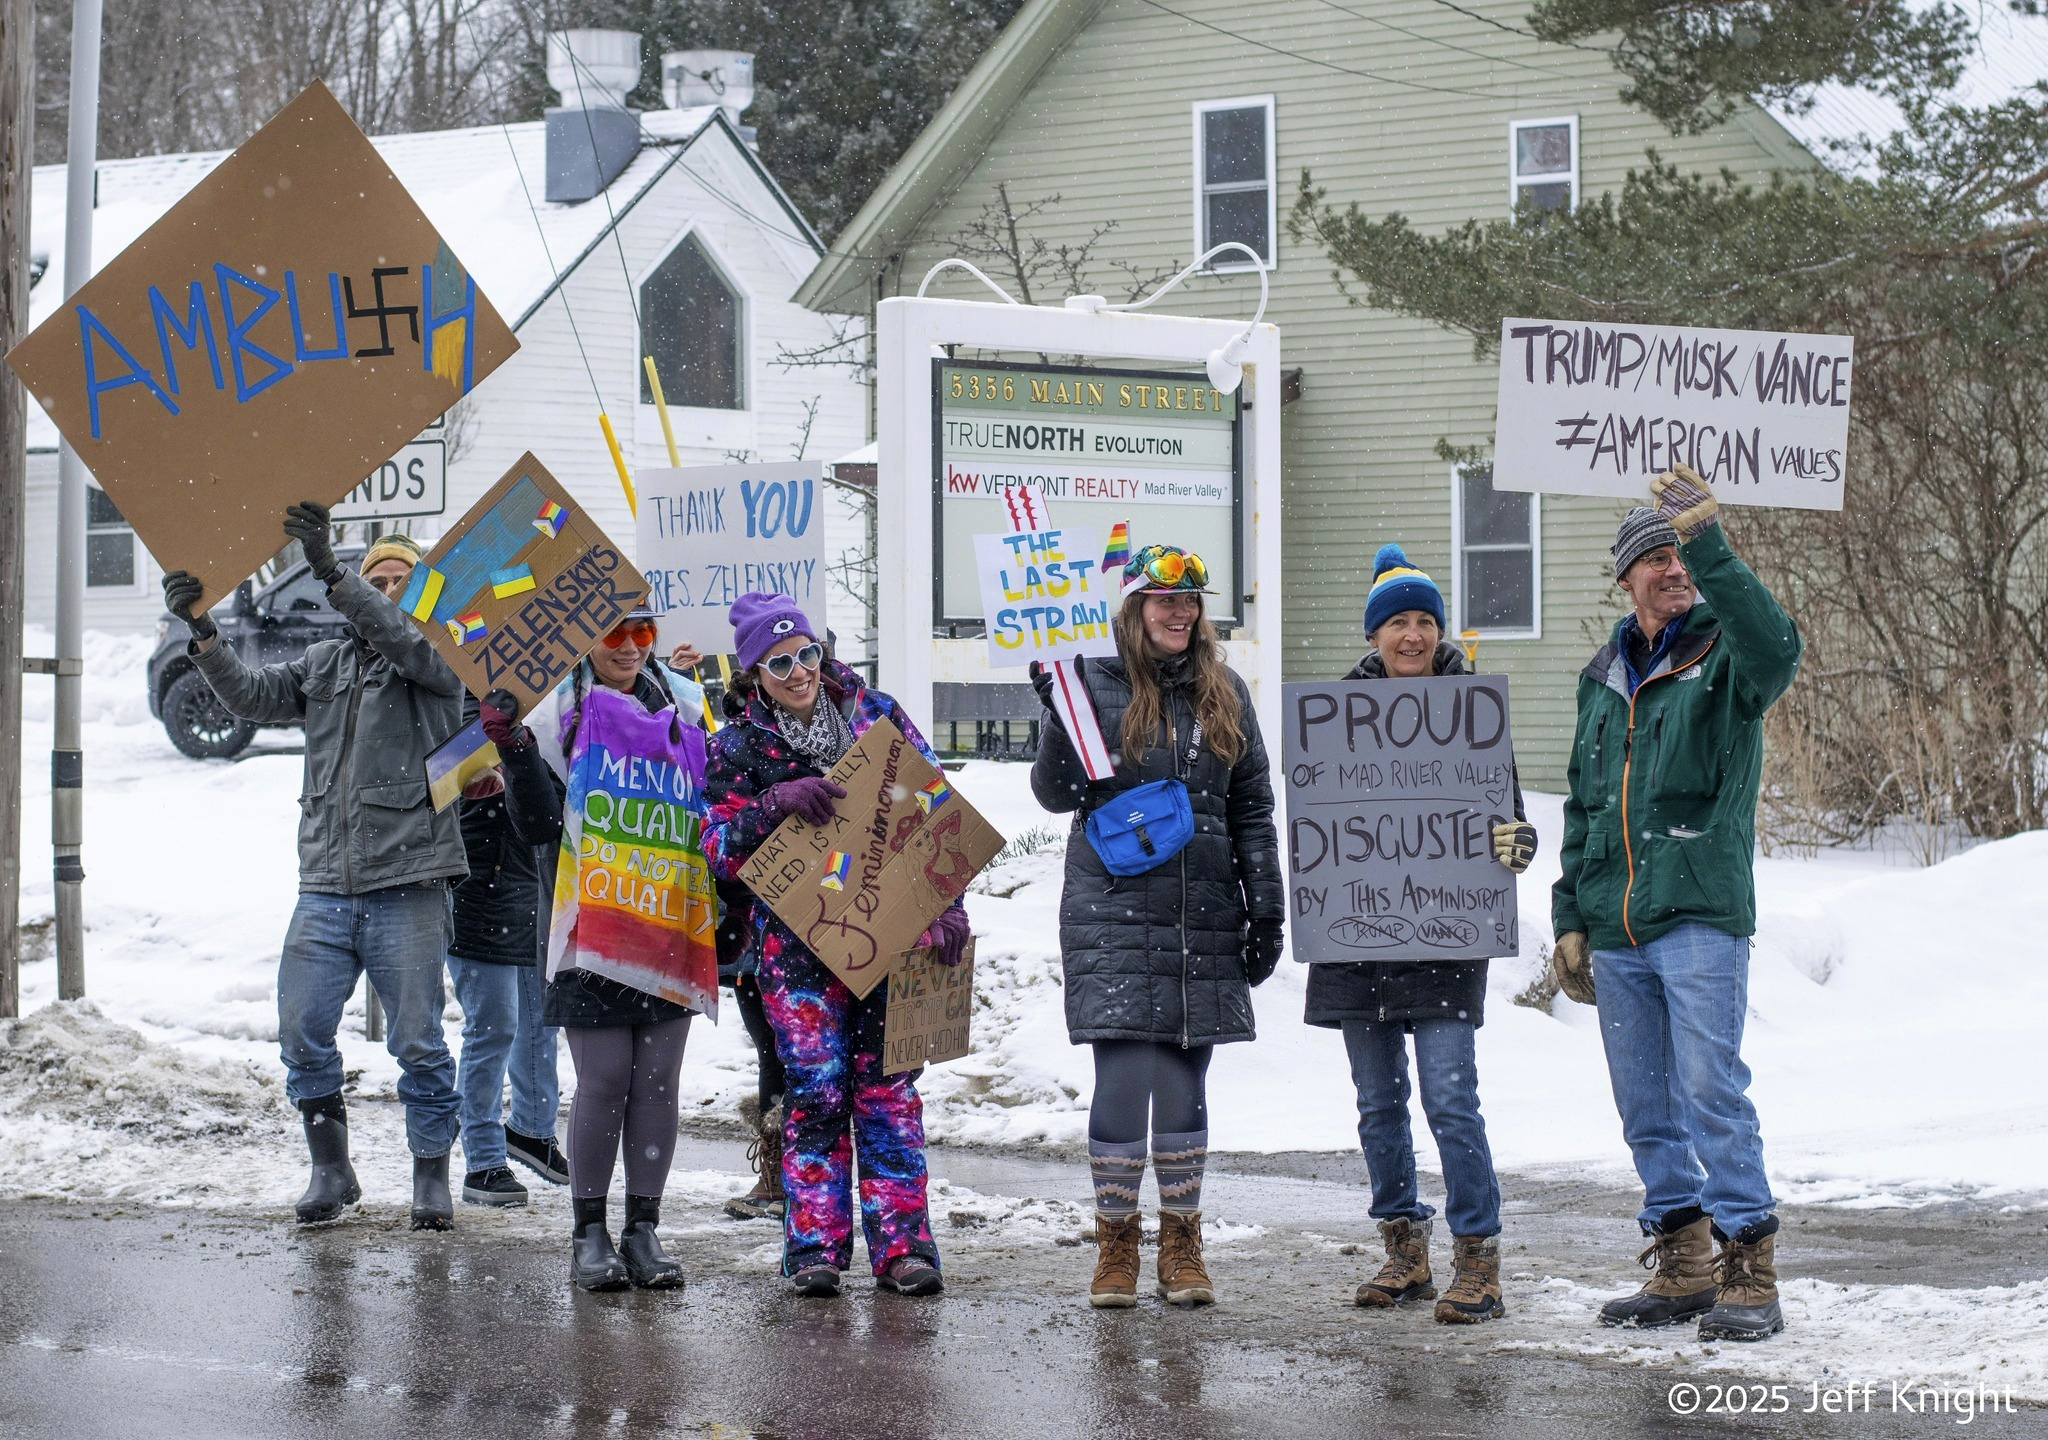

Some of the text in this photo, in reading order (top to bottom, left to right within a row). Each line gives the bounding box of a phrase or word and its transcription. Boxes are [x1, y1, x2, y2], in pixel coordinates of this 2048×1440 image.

[951, 373, 1225, 412] 5356 MAIN STREET
[1095, 435, 1183, 456] EVOLUTION
[1770, 446, 1841, 482] VALUES
[949, 463, 979, 493] kw
[1076, 477, 1139, 499] REALTY
[1145, 482, 1165, 495] Mad
[1169, 483, 1192, 496] River
[1195, 484, 1222, 500] Valley
[648, 478, 814, 539] THANK YOU
[1002, 530, 1065, 568] THE
[702, 557, 816, 607] ZELENSKYY
[1000, 560, 1094, 603] LAST
[514, 577, 643, 695] BETTER
[994, 600, 1107, 650] STRAW
[1298, 685, 1506, 753] PROUD
[598, 748, 668, 794] MEN
[1292, 759, 1511, 792] OF MAD RIVER VALLEY
[580, 833, 617, 864] DO
[745, 833, 788, 885] WHAT
[761, 814, 850, 906] NEED IS A
[1293, 886, 1328, 917] BY
[1342, 879, 1391, 914] THIS
[890, 957, 974, 1003] NEVER
[891, 1034, 924, 1066] NEVER
[925, 1028, 952, 1058] LIKED
